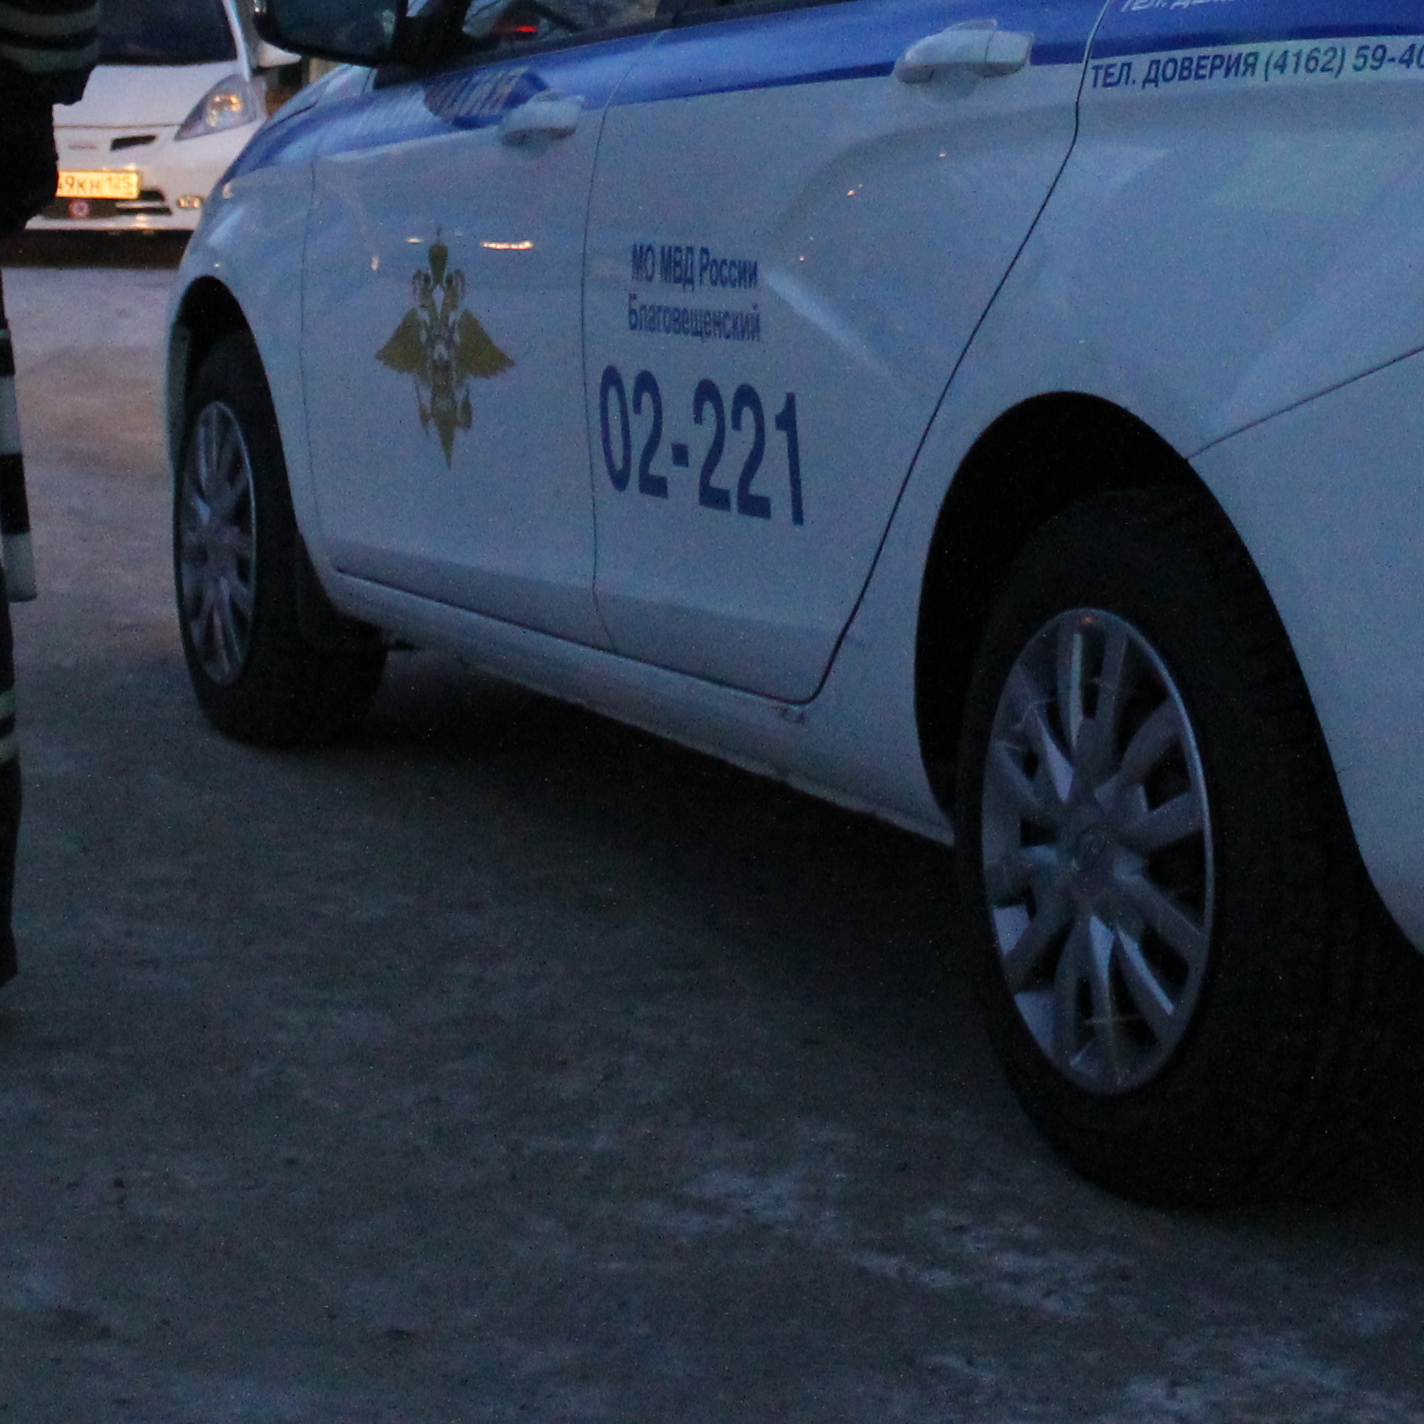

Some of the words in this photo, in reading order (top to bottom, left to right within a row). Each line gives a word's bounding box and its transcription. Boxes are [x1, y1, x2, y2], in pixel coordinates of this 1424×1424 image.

[1091, 62, 1136, 89] ТЕЛ.
[1141, 50, 1258, 89] ДОВЕРИЯ
[1264, 45, 1346, 81] (4162)
[631, 244, 655, 282] МО
[660, 245, 695, 293] МВД
[699, 247, 758, 289] России
[628, 293, 760, 343] Благовещенский
[599, 364, 804, 526] 02-221
